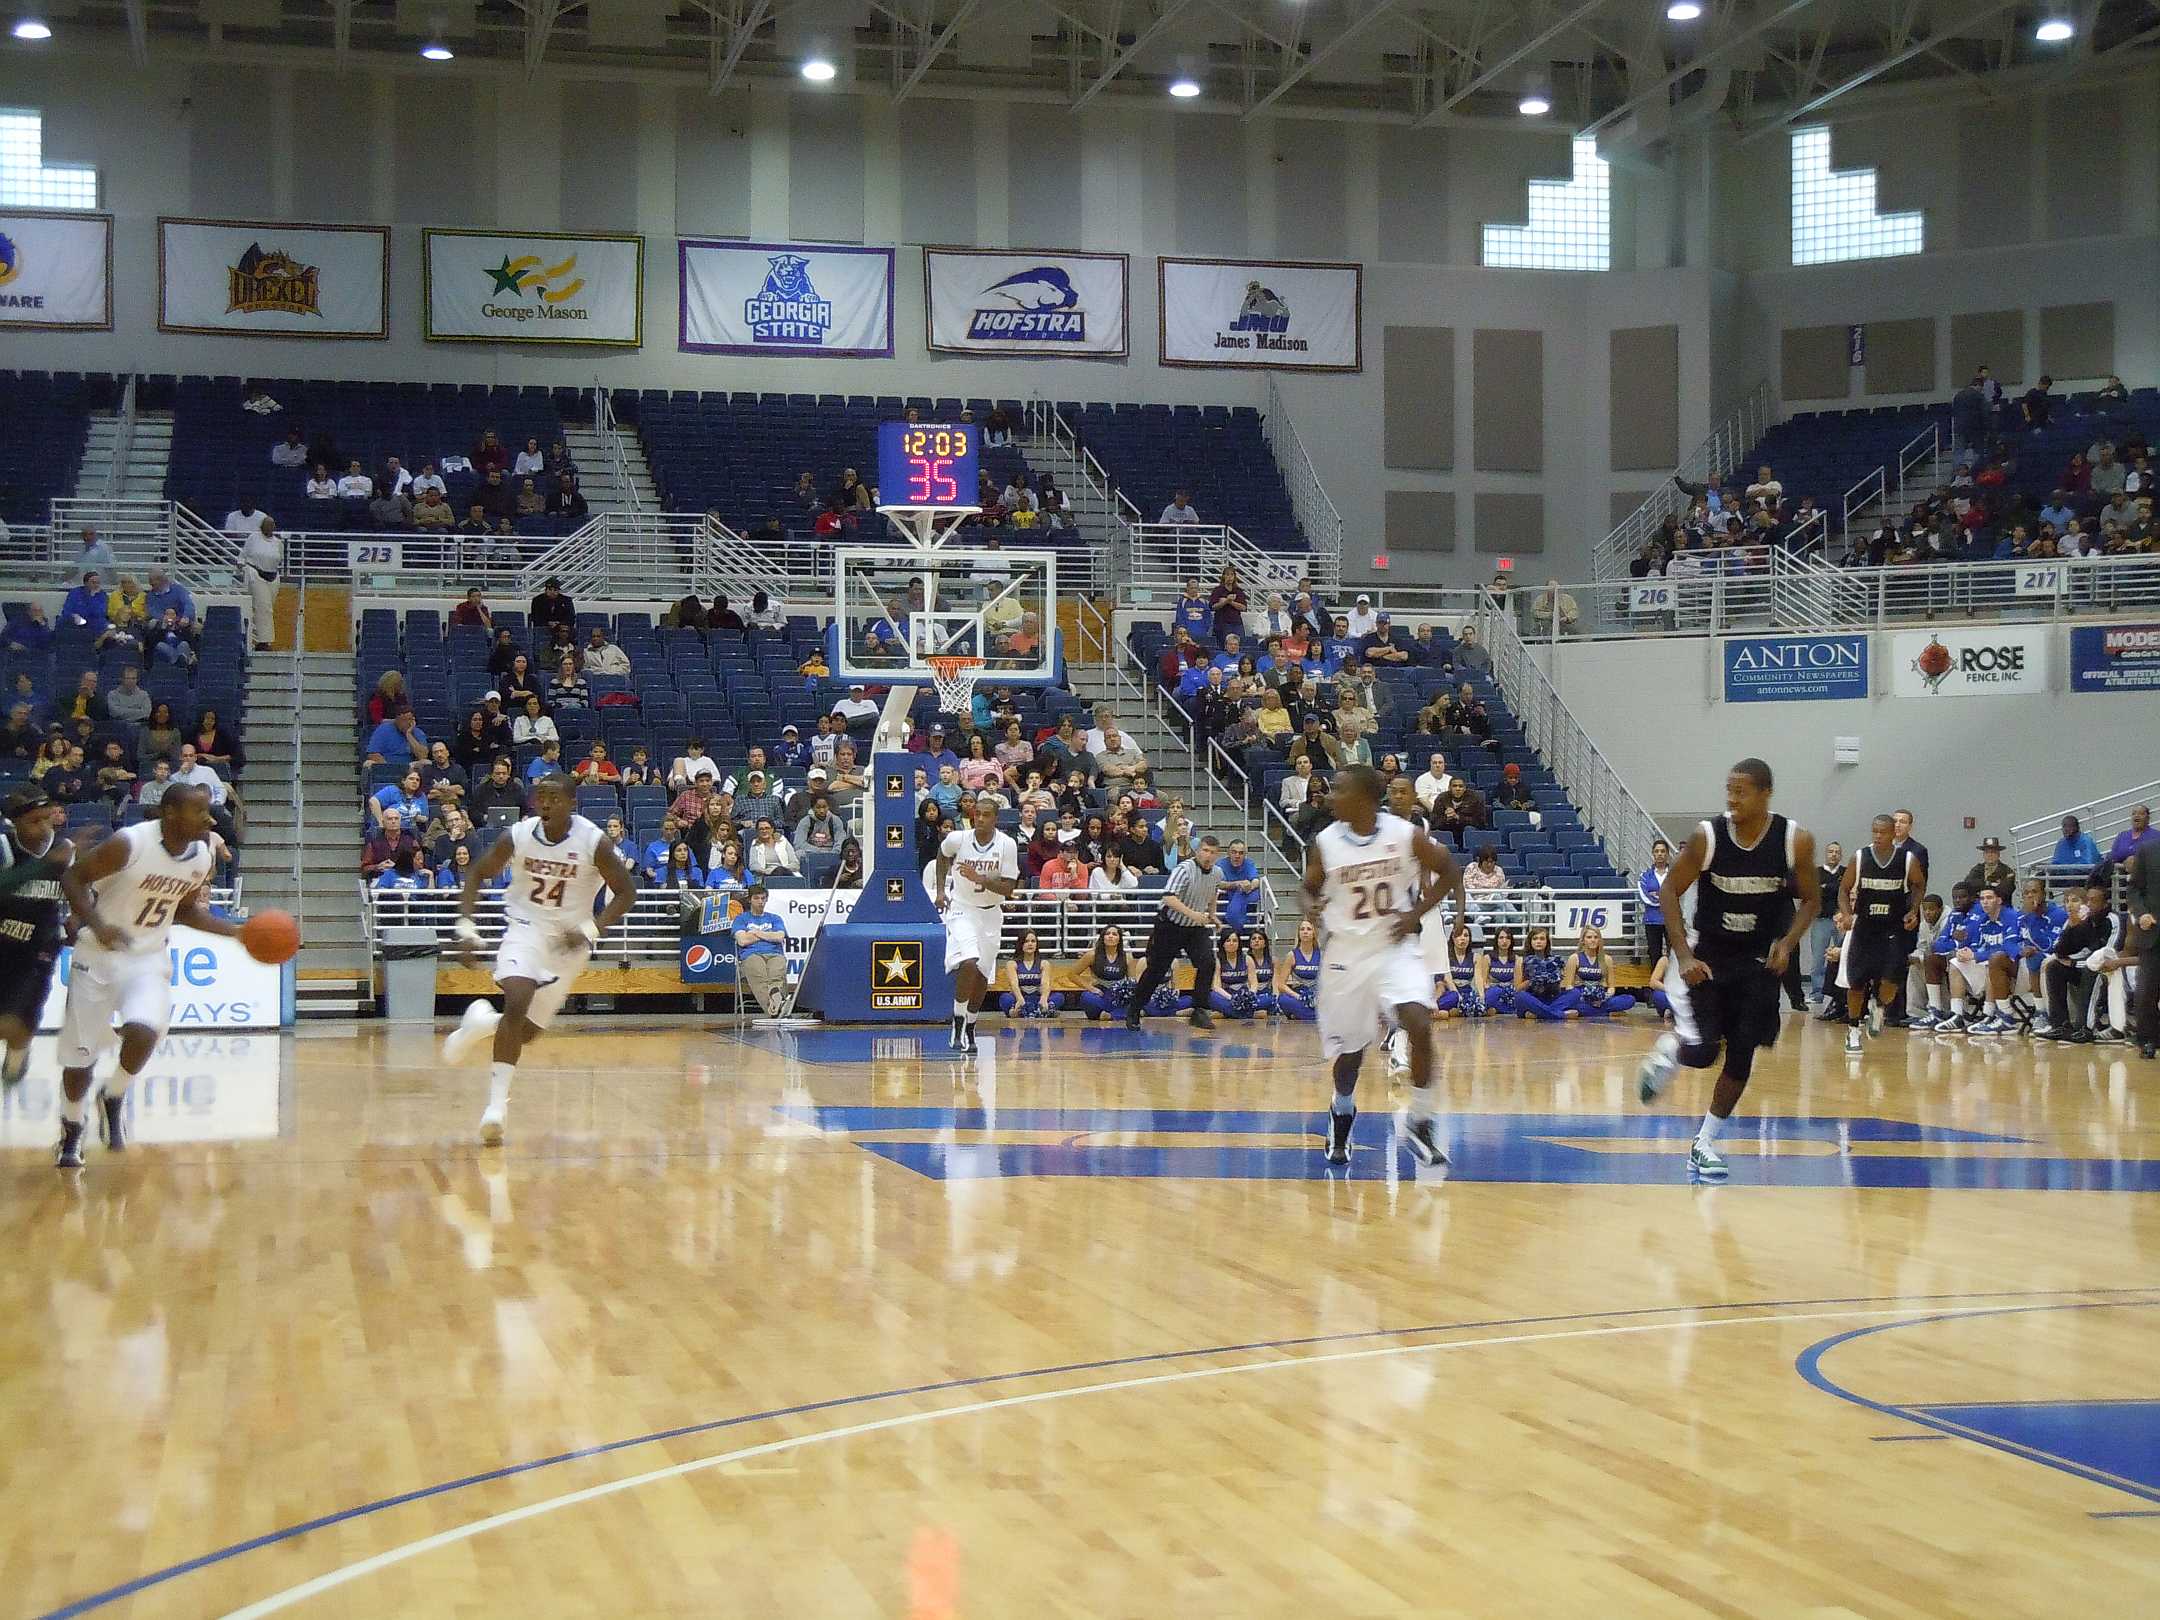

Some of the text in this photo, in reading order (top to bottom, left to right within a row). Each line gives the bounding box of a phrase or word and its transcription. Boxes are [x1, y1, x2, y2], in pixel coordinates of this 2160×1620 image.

[482, 303, 588, 321] George Mason
[747, 301, 830, 327] GEORGIA
[974, 312, 1081, 332] HOFSTRA
[755, 321, 821, 338] STATE
[1229, 313, 1290, 333] JMU
[1214, 332, 1308, 351] James Madison
[904, 431, 967, 456] 12:03
[909, 459, 957, 501] 35
[357, 546, 392, 562] 213
[2024, 571, 2057, 588] 217
[1639, 588, 1668, 604] 216
[1732, 642, 1861, 669] ANTON
[1960, 645, 2024, 672] ROSE
[1757, 685, 1828, 694] antonnews.com
[530, 877, 567, 907] 24
[1353, 882, 1394, 920] 20
[135, 898, 173, 927] 15
[1568, 907, 1608, 929] 116
[877, 996, 917, 1006] U.S.ARMY
